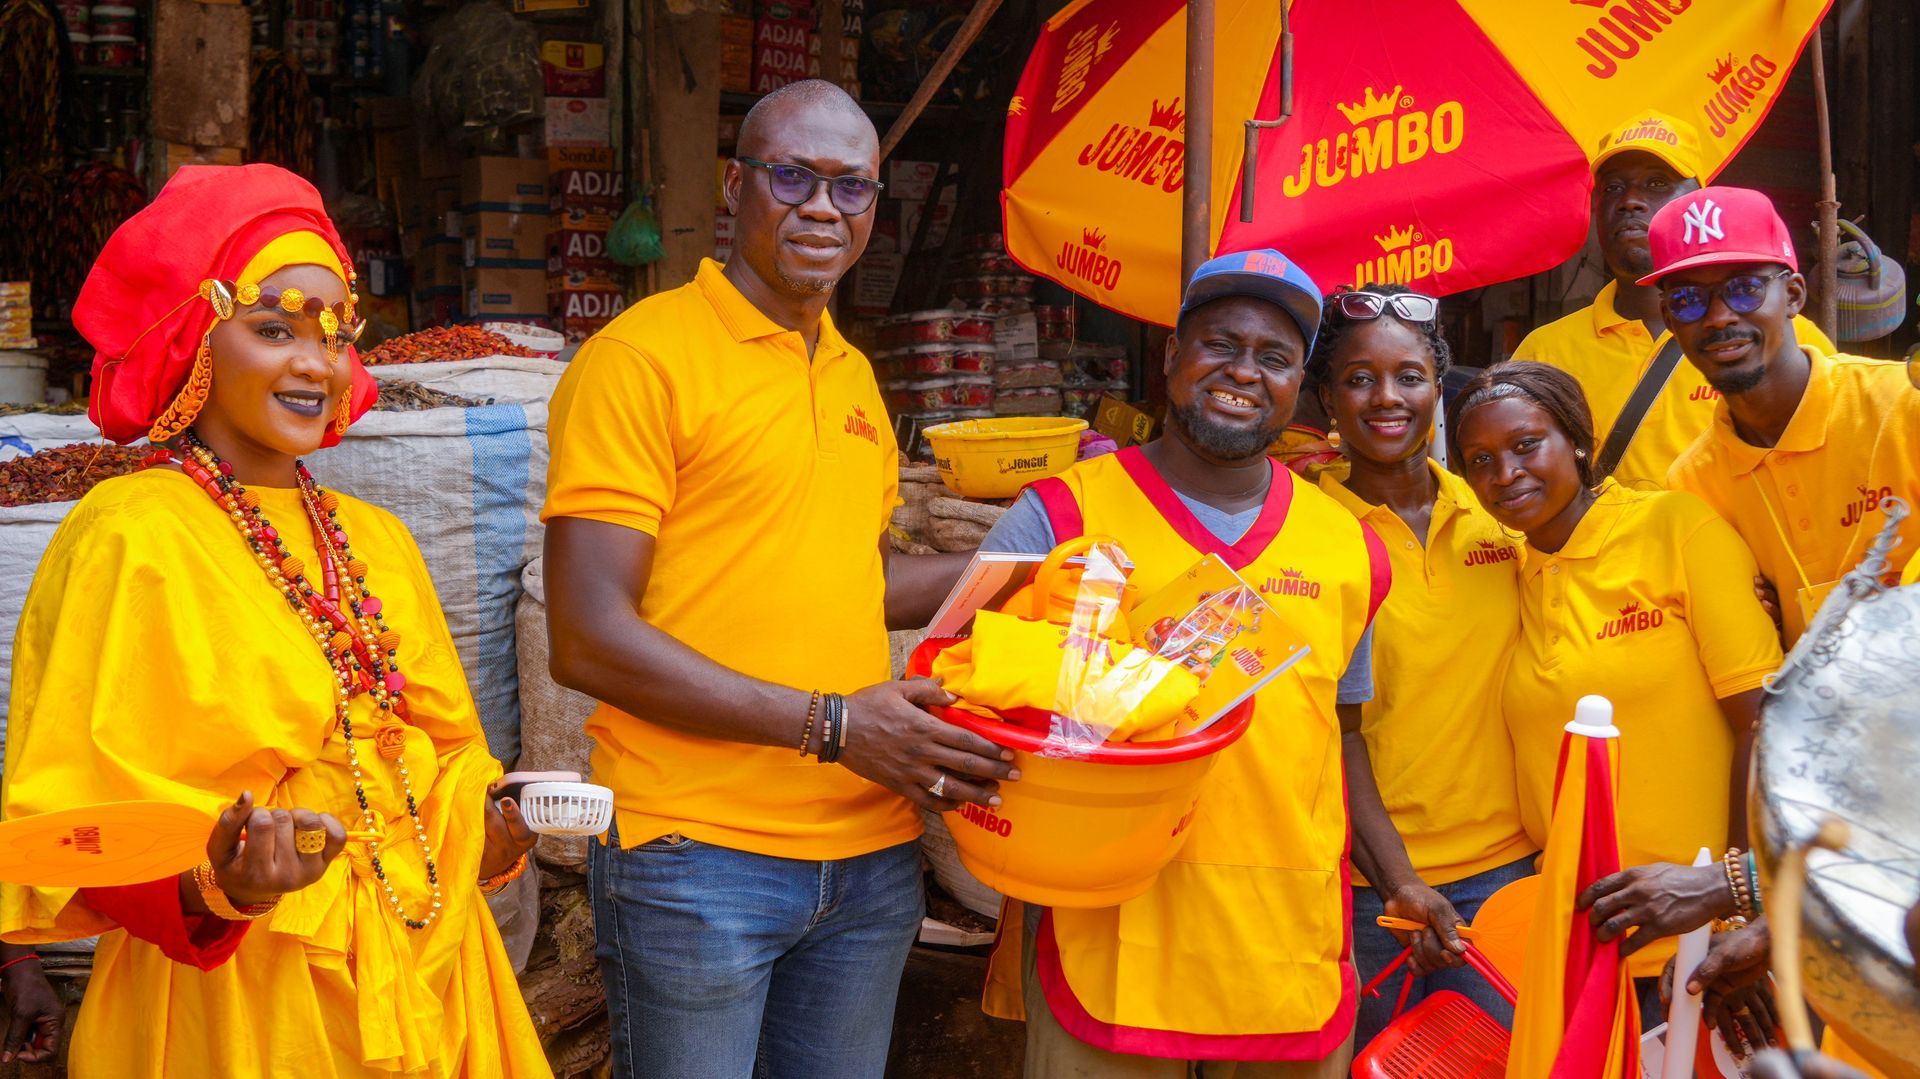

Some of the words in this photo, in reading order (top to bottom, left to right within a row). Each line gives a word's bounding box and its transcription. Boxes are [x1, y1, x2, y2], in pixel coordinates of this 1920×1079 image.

[760, 23, 805, 47] ADJA
[761, 48, 805, 73] ADJA
[1051, 24, 1100, 113] JUMBO
[1704, 53, 1777, 138] JUMBO
[1282, 100, 1464, 198] JUMBO
[1615, 127, 1678, 146] JUMBO
[566, 170, 624, 196] ADJA
[1683, 199, 1725, 245] NY
[1057, 241, 1122, 291] JUMBO
[566, 293, 625, 318] ADJA
[844, 414, 878, 446] JUMBO
[1464, 545, 1518, 567] JUMBO
[1259, 577, 1320, 600] JUMBO
[1596, 608, 1664, 640] JUMBO
[1230, 647, 1265, 677] JUMBO
[956, 802, 1012, 837] UMBO
[72, 826, 103, 854] JUMBO
